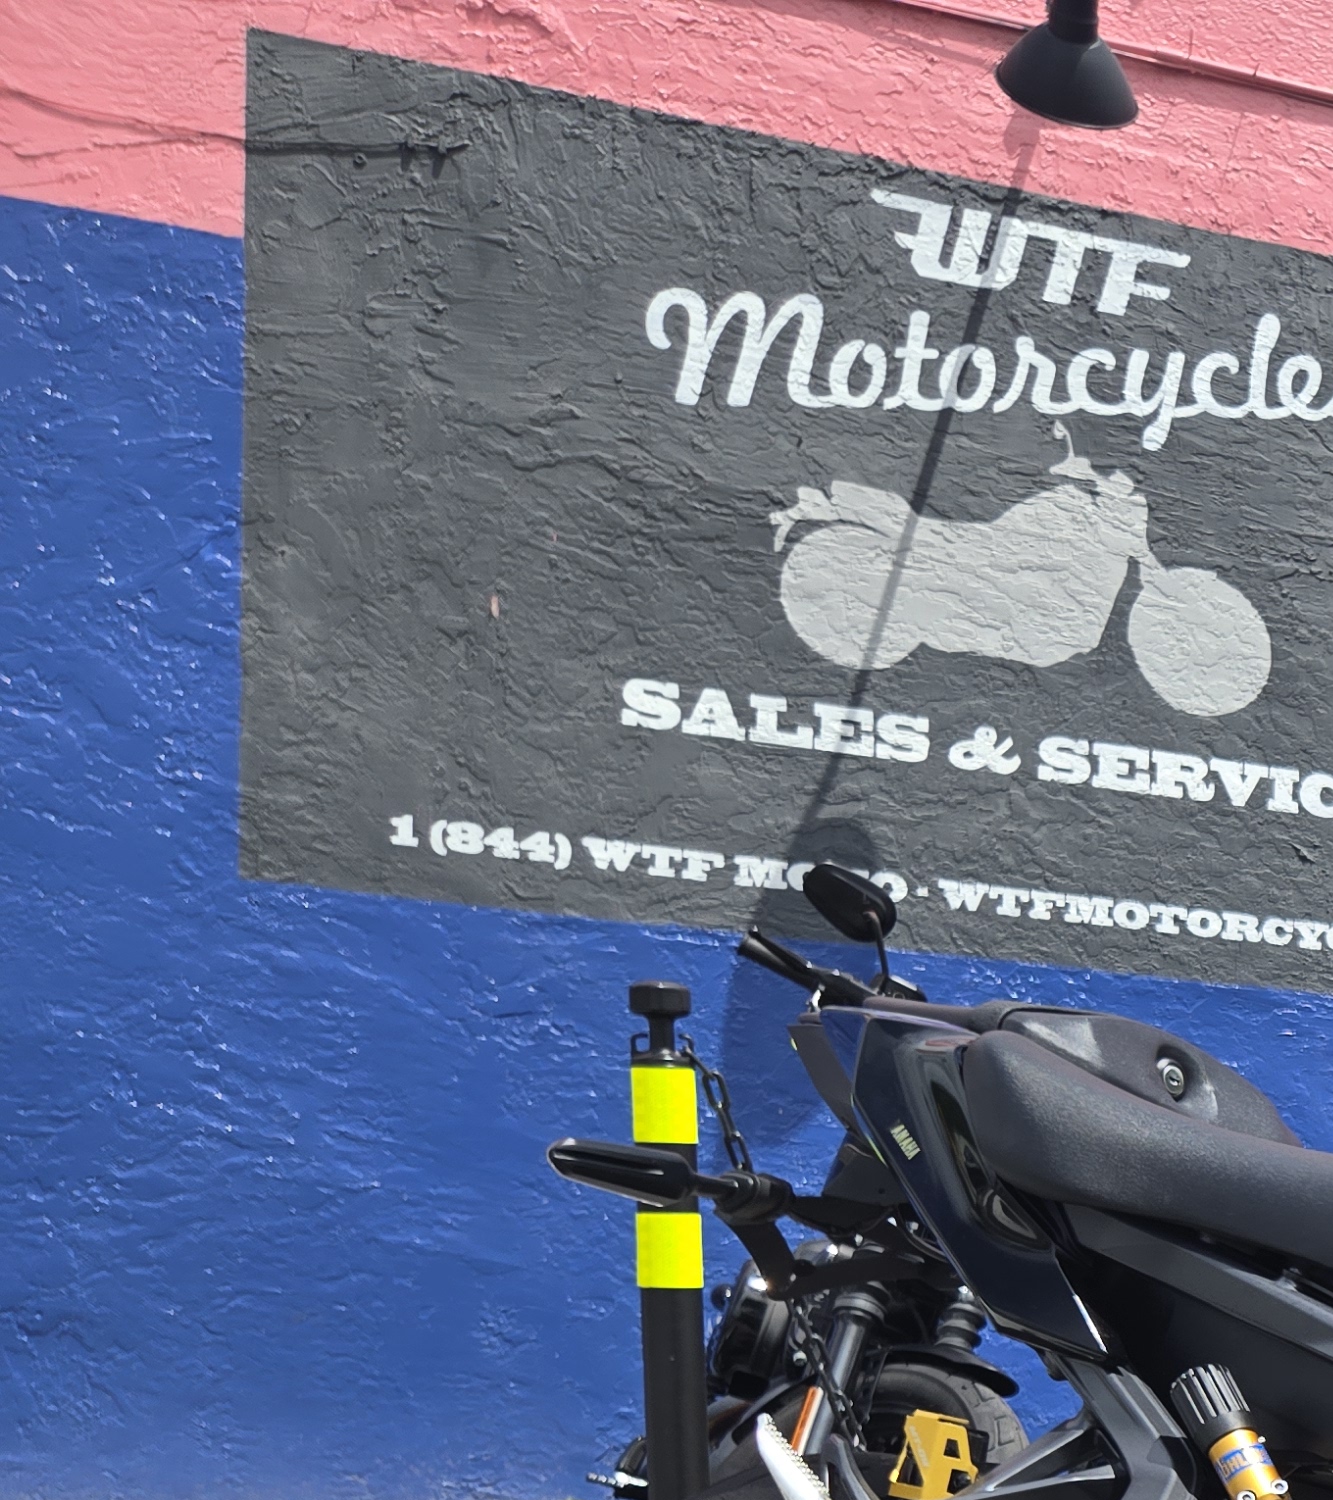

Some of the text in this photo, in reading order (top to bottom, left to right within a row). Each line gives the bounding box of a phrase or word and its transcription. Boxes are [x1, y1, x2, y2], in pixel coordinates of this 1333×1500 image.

[621, 677, 930, 763] SALES
[948, 726, 1021, 775] &
[389, 814, 419, 848] 1
[429, 819, 572, 870] (844)
[581, 836, 725, 882] WTF
[733, 854, 909, 904] MO
